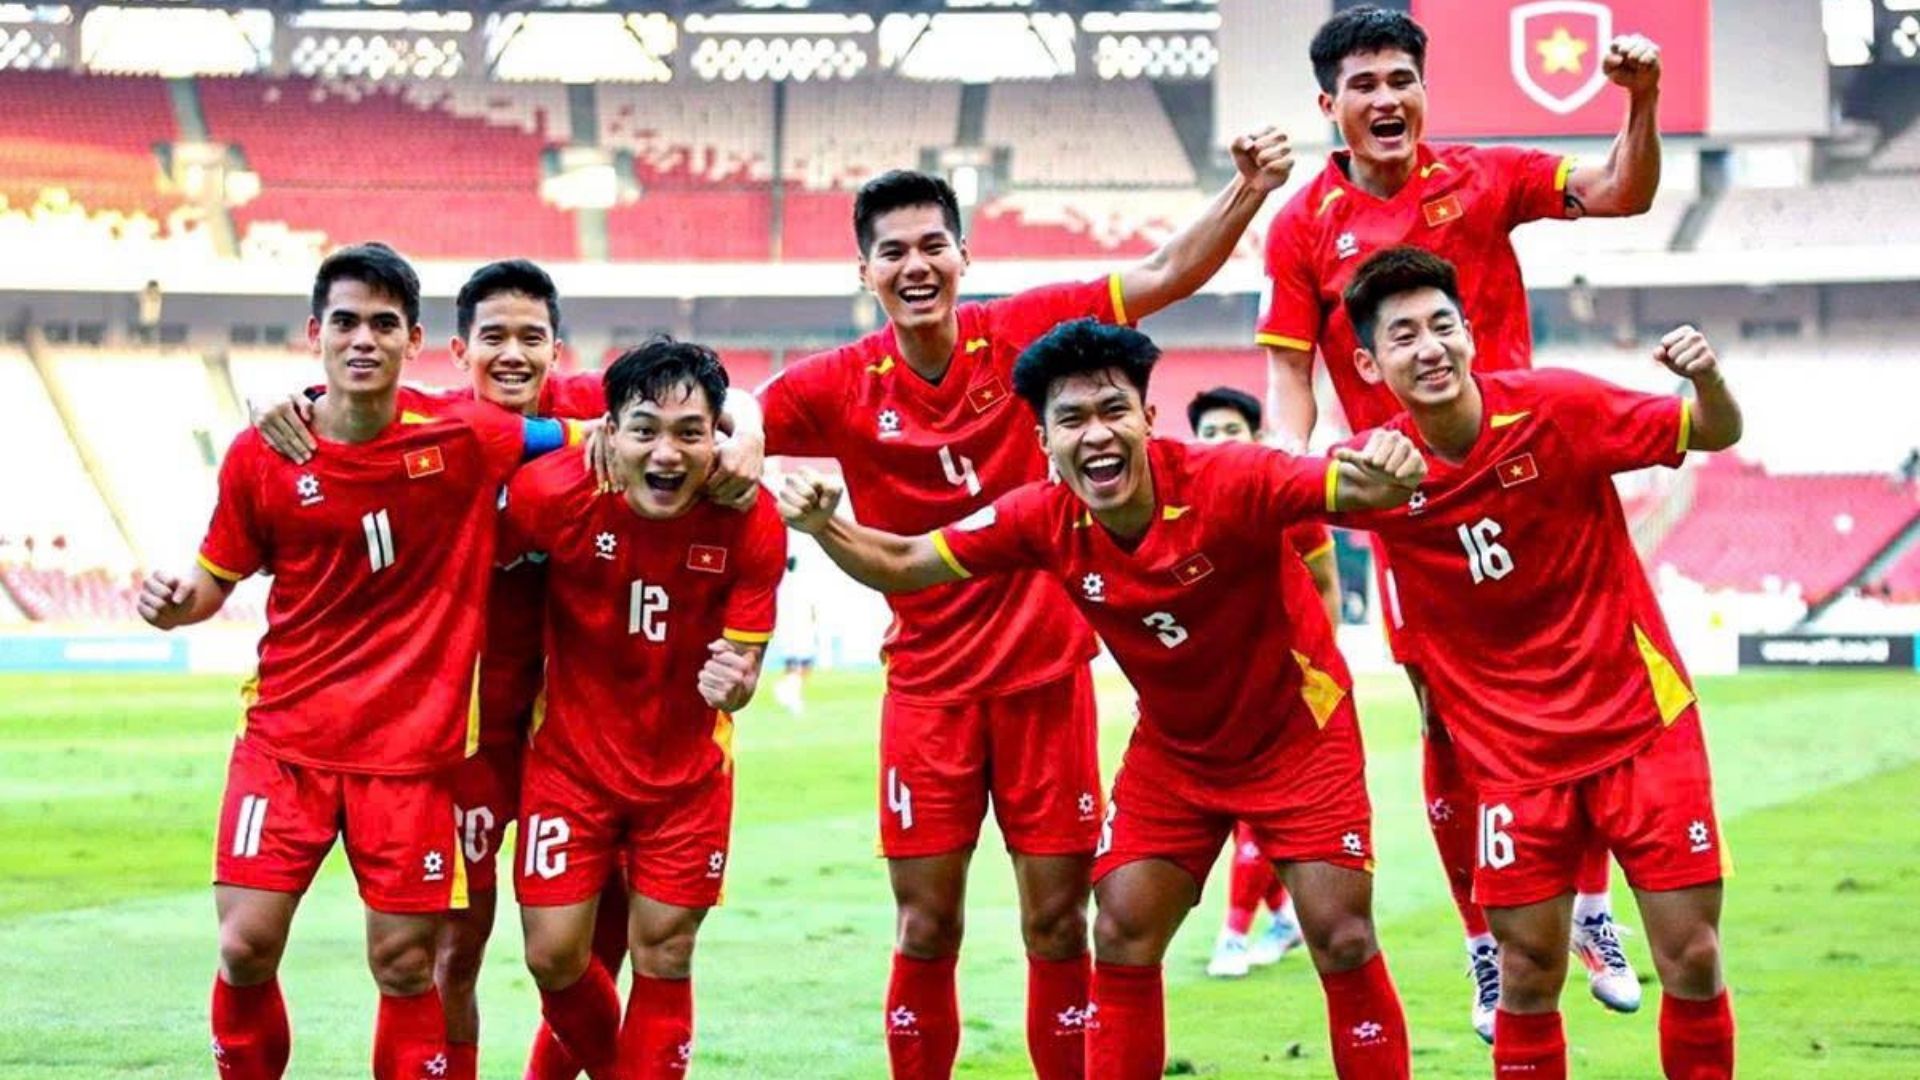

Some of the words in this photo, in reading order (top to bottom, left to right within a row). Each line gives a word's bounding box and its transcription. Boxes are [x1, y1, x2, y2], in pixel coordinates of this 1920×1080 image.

[938, 445, 981, 496] 4
[362, 509, 395, 572] 11
[1457, 518, 1514, 585] 16
[628, 580, 669, 641] 12
[1143, 612, 1187, 648] 3
[231, 794, 268, 857] 11
[887, 767, 912, 830] 4
[524, 814, 571, 880] 12
[1477, 802, 1516, 870] 16
